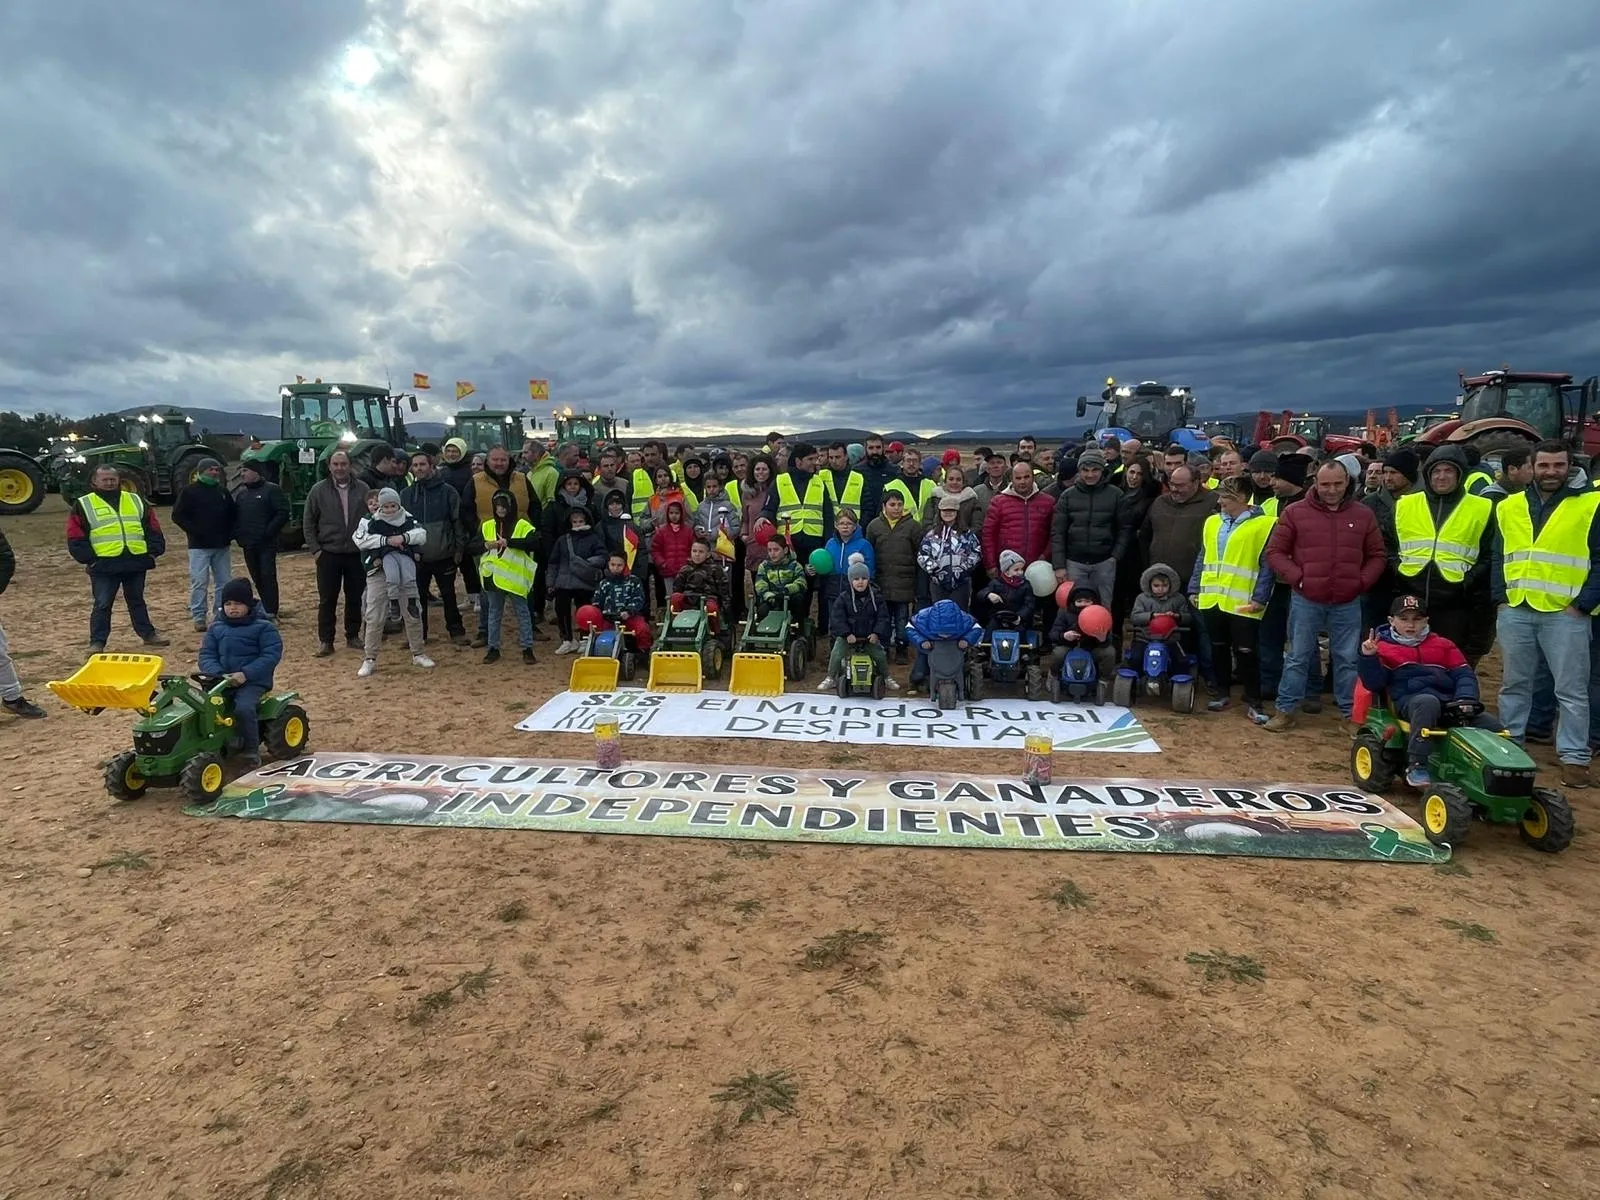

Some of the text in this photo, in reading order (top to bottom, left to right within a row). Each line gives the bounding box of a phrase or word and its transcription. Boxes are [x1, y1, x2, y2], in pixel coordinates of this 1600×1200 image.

[696, 698, 1101, 723] El Mundo Rural
[725, 716, 1027, 740] DESPIERTA
[257, 759, 1386, 816] AGRICULTORES Y GANADEROS
[436, 792, 1158, 841] INDEPENDIENTES
